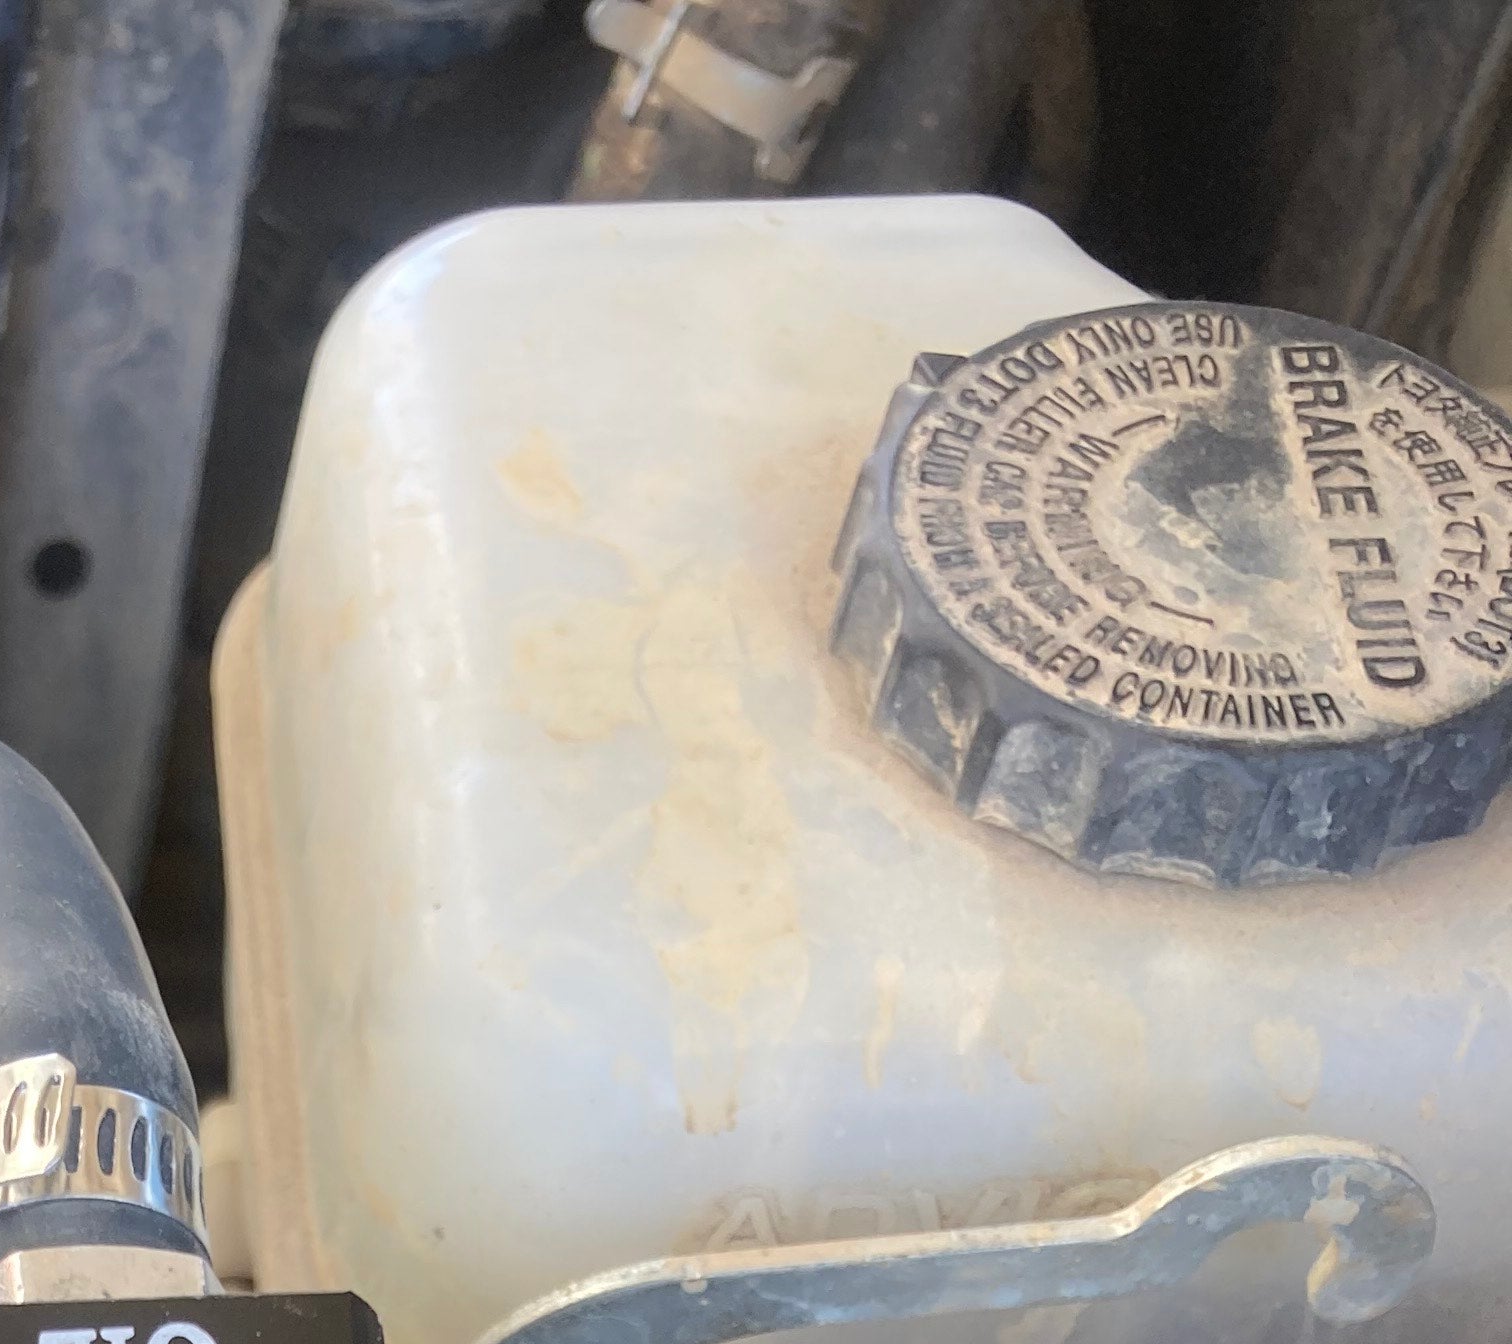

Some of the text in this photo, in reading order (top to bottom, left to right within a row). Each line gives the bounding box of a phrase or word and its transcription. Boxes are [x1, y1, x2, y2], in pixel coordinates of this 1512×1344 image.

[1066, 315, 1156, 365] ONLY
[1166, 313, 1241, 349] USE
[1104, 353, 1222, 396] CLEAN
[993, 377, 1104, 455] FILLER
[919, 411, 982, 489] FLUID
[1280, 344, 1427, 689] BRAKE FLUID
[1084, 614, 1298, 688] REMOVING
[1112, 669, 1346, 730] CONTAINER
